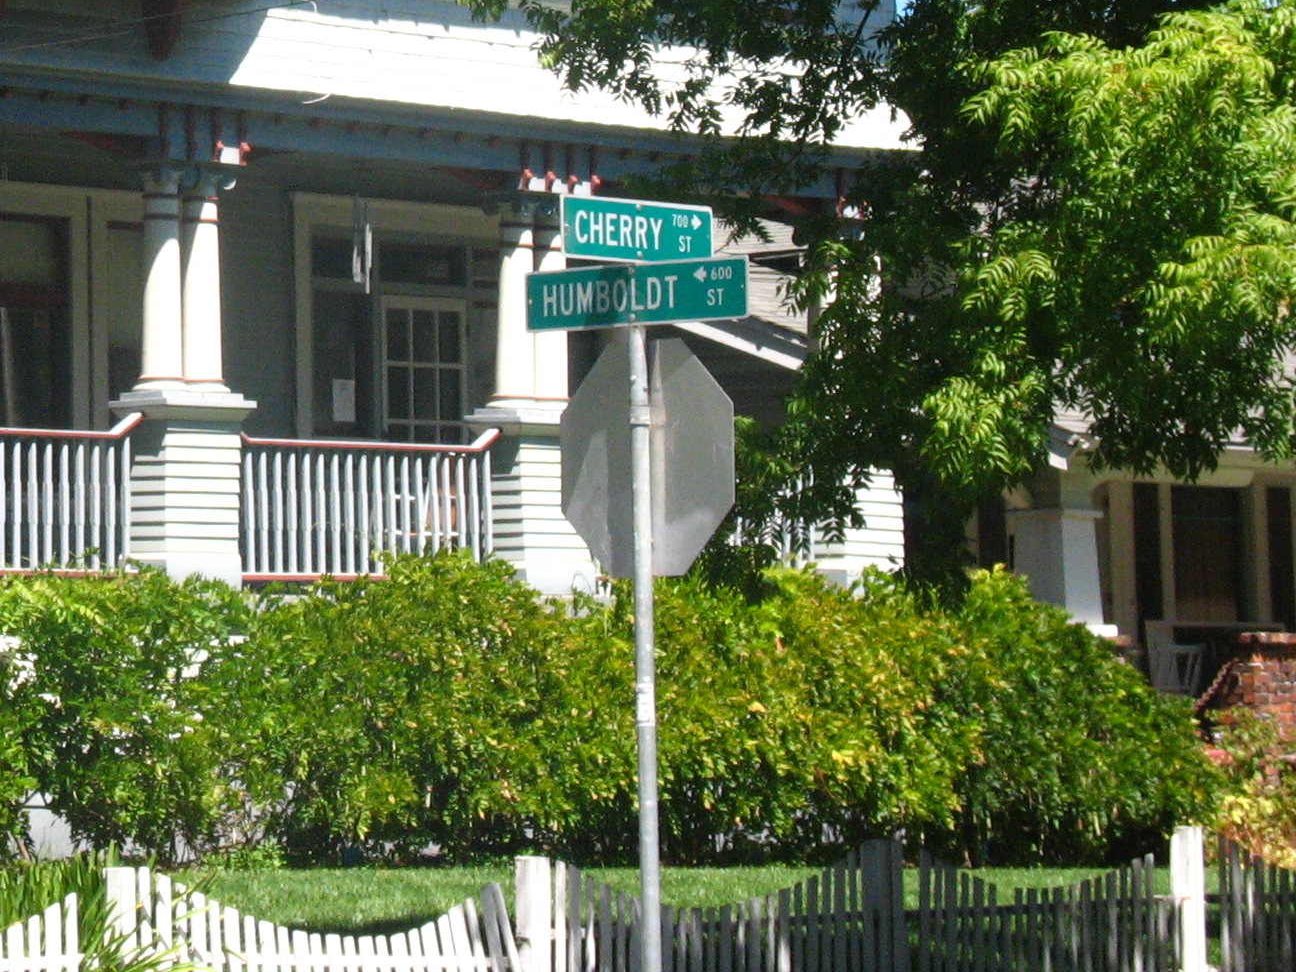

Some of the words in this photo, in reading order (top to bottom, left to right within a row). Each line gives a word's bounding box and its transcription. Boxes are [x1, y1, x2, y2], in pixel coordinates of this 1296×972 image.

[575, 210, 663, 250] CHERRY
[672, 214, 688, 228] 700
[678, 235, 692, 253] ST
[710, 266, 732, 280] 600
[543, 275, 678, 317] HUMBOLDT
[707, 288, 724, 306] ST
